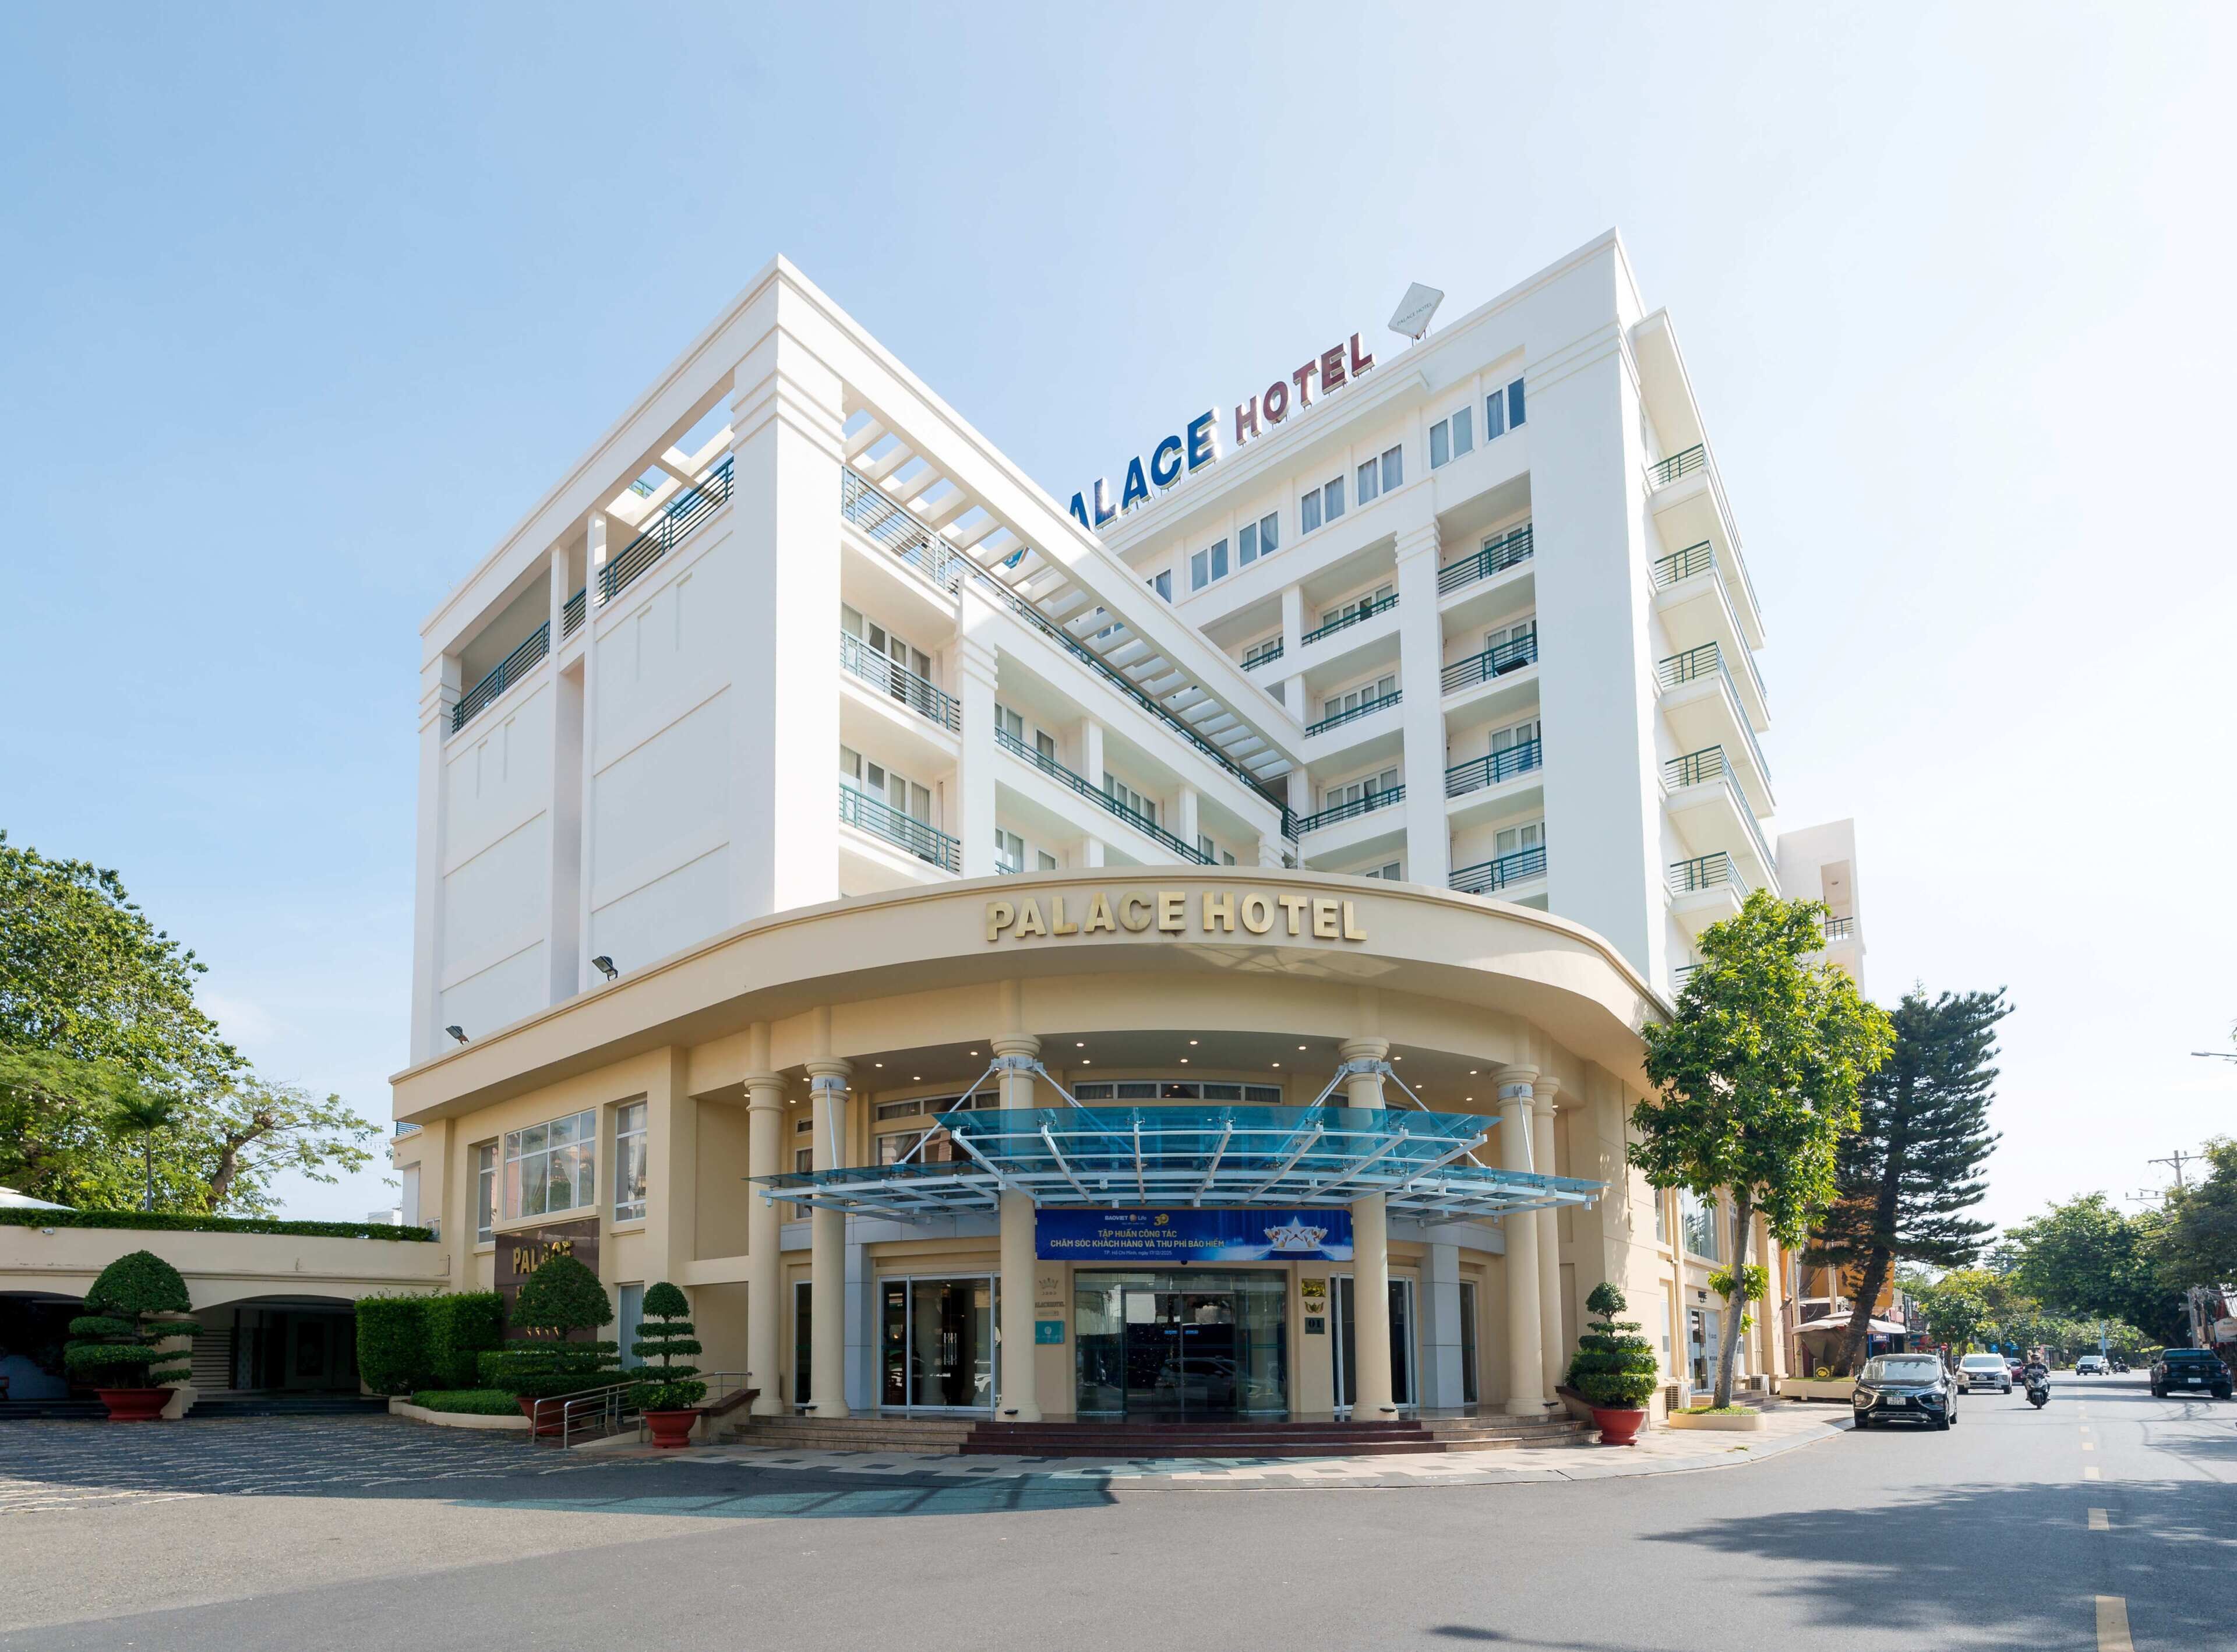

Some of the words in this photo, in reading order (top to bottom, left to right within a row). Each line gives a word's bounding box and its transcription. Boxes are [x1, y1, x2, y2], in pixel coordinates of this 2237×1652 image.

[1069, 406, 1221, 534] ALACE
[1236, 332, 1375, 446] HOTEL
[986, 891, 1186, 941] PALACE
[1202, 891, 1368, 941] HOTEL
[1050, 1238, 1073, 1247] CHĂM
[1075, 1238, 1091, 1247] SÓC
[1121, 1238, 1142, 1247] HÀNG
[1145, 1238, 1155, 1247] VÀ
[1174, 1238, 1187, 1247] PHÍ
[1115, 1228, 1137, 1237] HUẤN
[1139, 1229, 1160, 1237] CÔNG
[1162, 1229, 1177, 1237] TÁC
